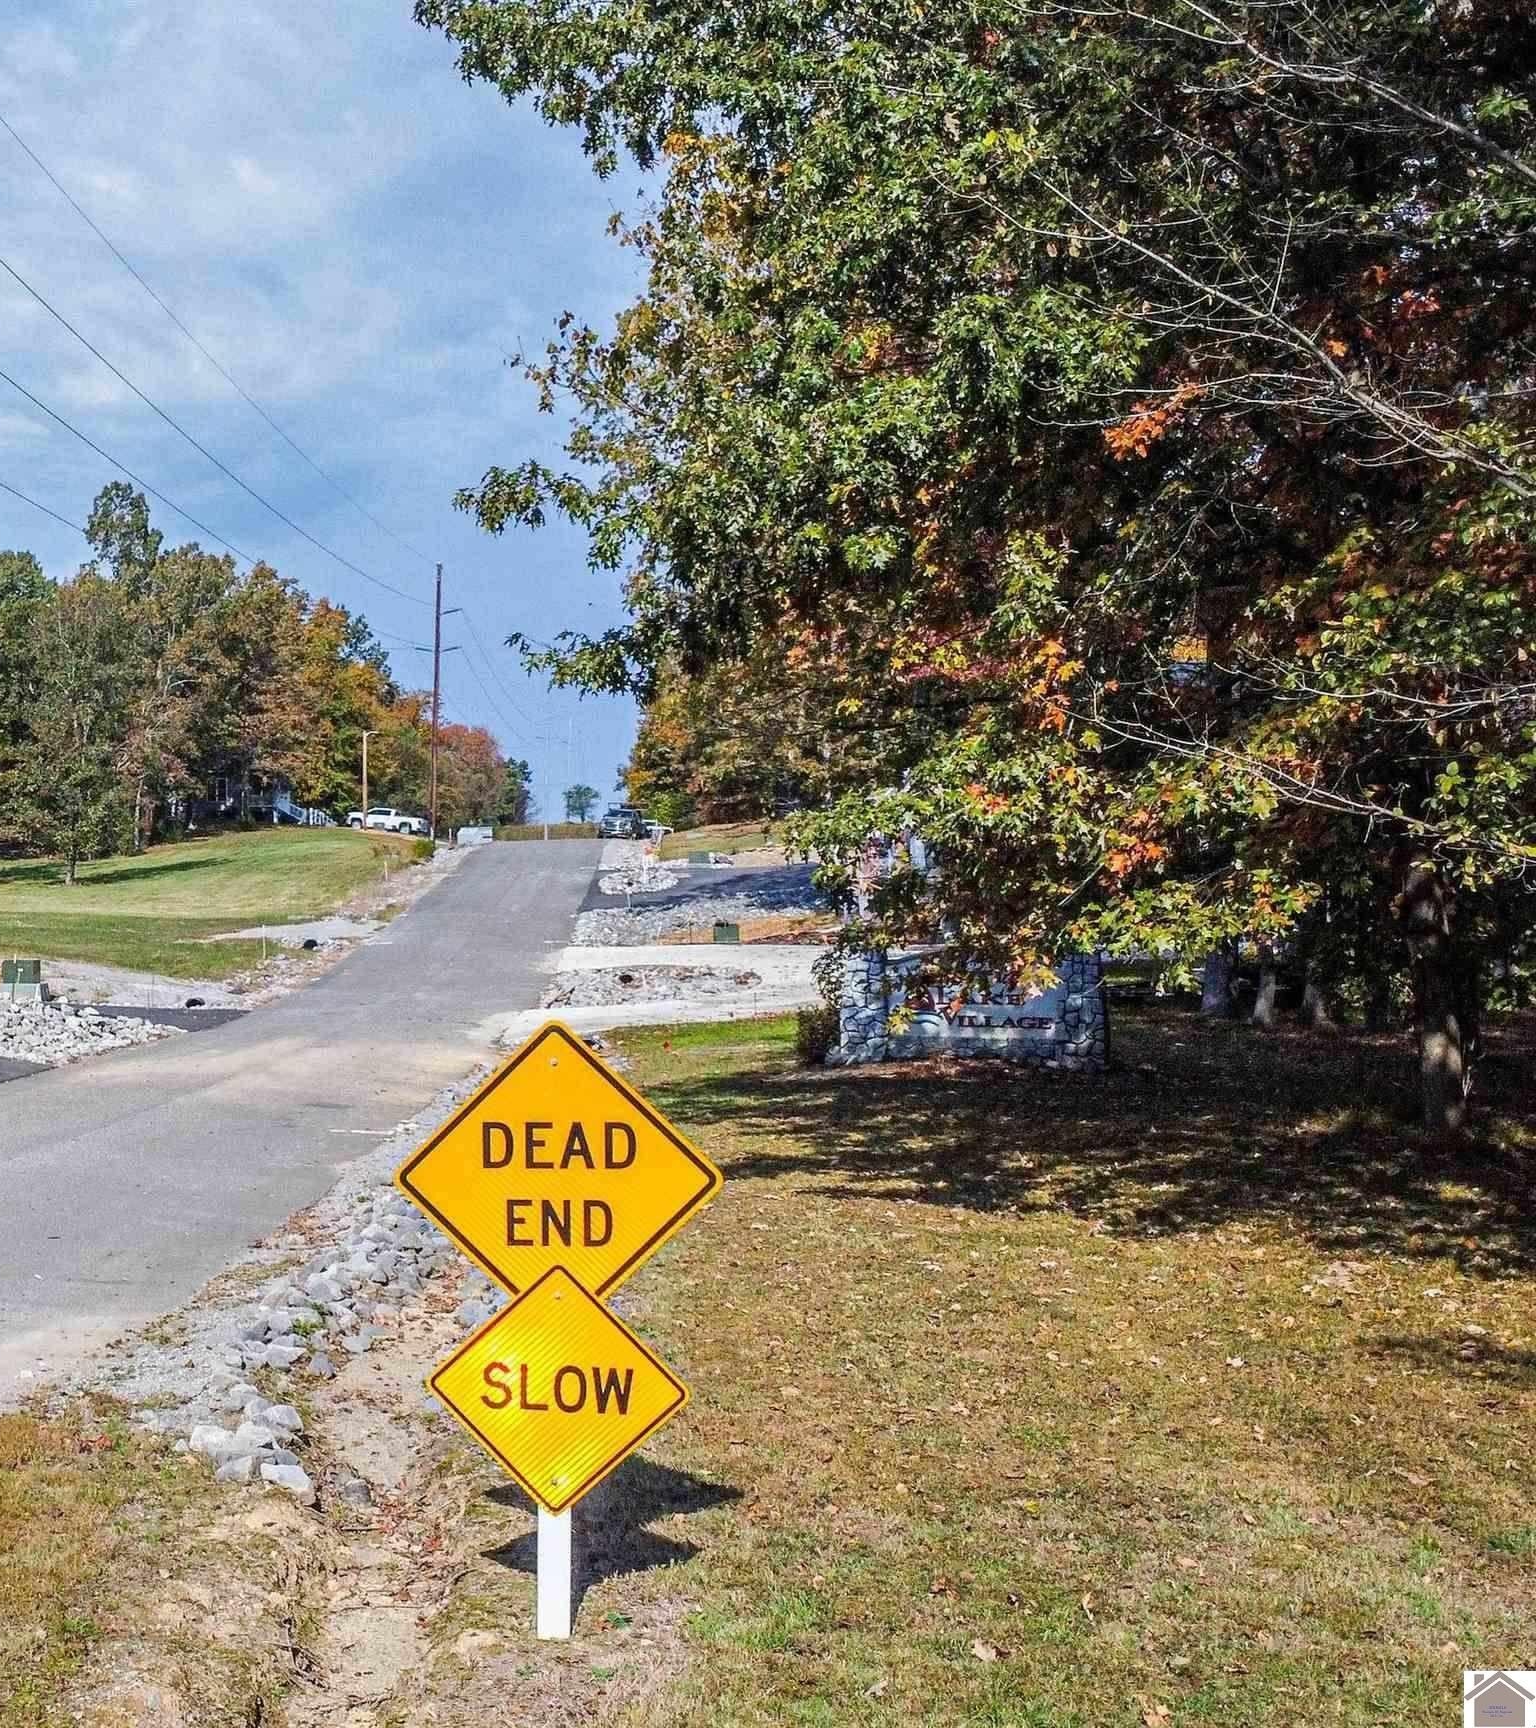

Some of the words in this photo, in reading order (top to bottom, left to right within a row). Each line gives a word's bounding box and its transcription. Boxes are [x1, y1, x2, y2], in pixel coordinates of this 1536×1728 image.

[940, 1007, 1052, 1030] VILLAGE
[482, 1121, 637, 1170] DEAD
[506, 1199, 613, 1247] END
[481, 1362, 634, 1415] SLOW
